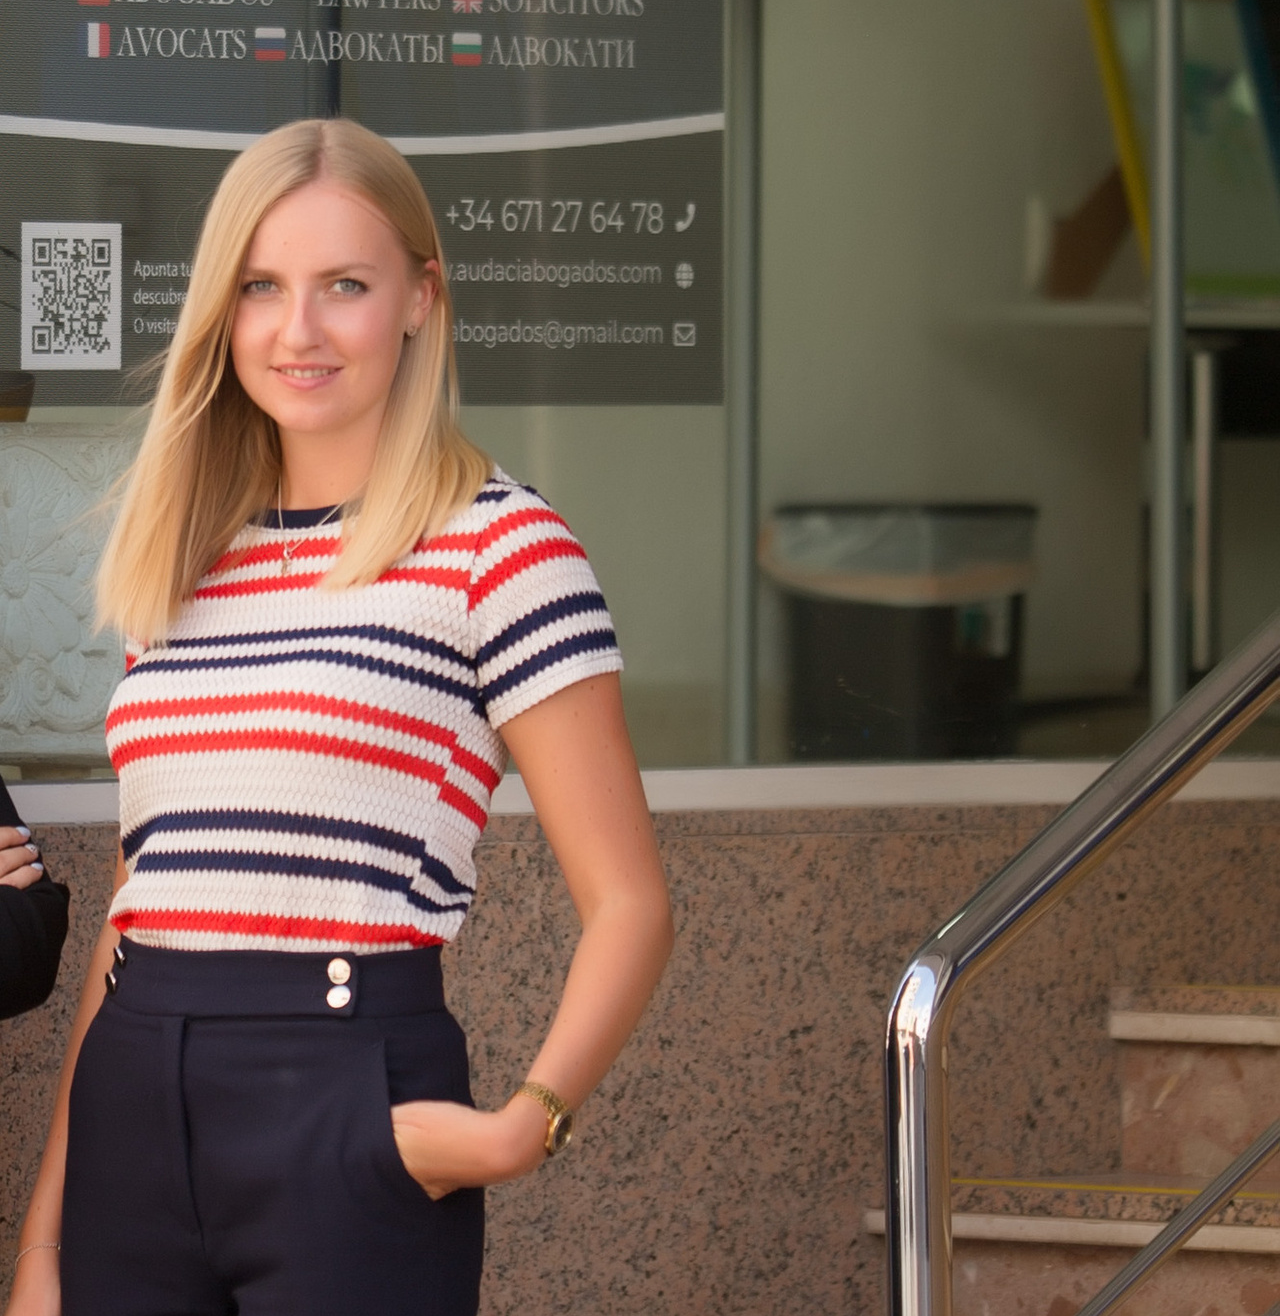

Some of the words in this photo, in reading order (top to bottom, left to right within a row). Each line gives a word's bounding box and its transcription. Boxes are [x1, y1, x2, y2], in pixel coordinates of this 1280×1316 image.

[116, 26, 248, 60] AVOCATS
[445, 199, 495, 232] +34
[500, 199, 543, 233] 671
[551, 200, 583, 233] 27
[589, 200, 625, 234] 64
[630, 201, 665, 235] 78
[133, 259, 179, 282] Apunta
[133, 317, 145, 334] O
